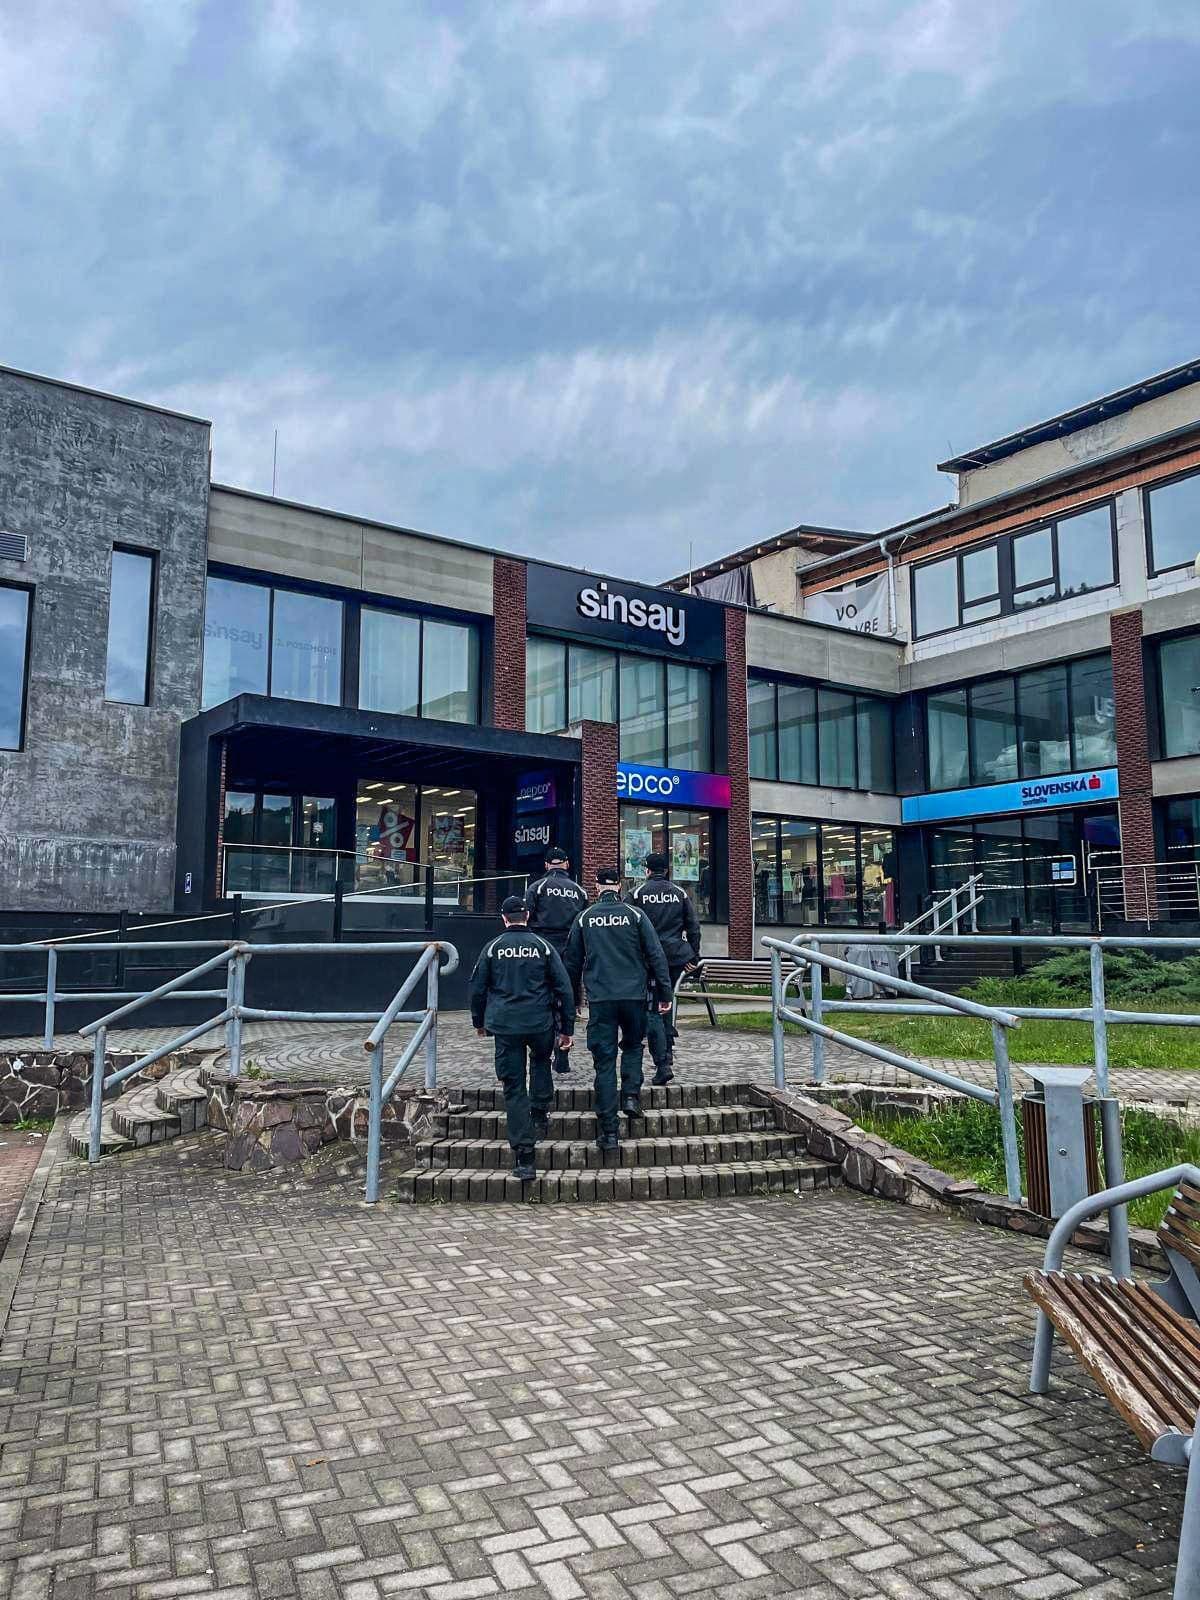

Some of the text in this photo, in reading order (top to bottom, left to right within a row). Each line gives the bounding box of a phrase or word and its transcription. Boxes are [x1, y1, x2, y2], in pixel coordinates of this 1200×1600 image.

[577, 582, 686, 646] sinsay
[836, 604, 857, 621] VO
[848, 618, 879, 633] VBE
[204, 620, 263, 650] sinsay
[617, 770, 680, 796] epco®
[1021, 777, 1087, 798] SLOVENSKÁ
[515, 825, 550, 845] sinsay
[547, 887, 579, 900] POLÍCIA
[642, 892, 680, 905] POLÍCIA
[589, 914, 630, 927] POLÍCIA
[497, 945, 540, 959] POLÍCIA
